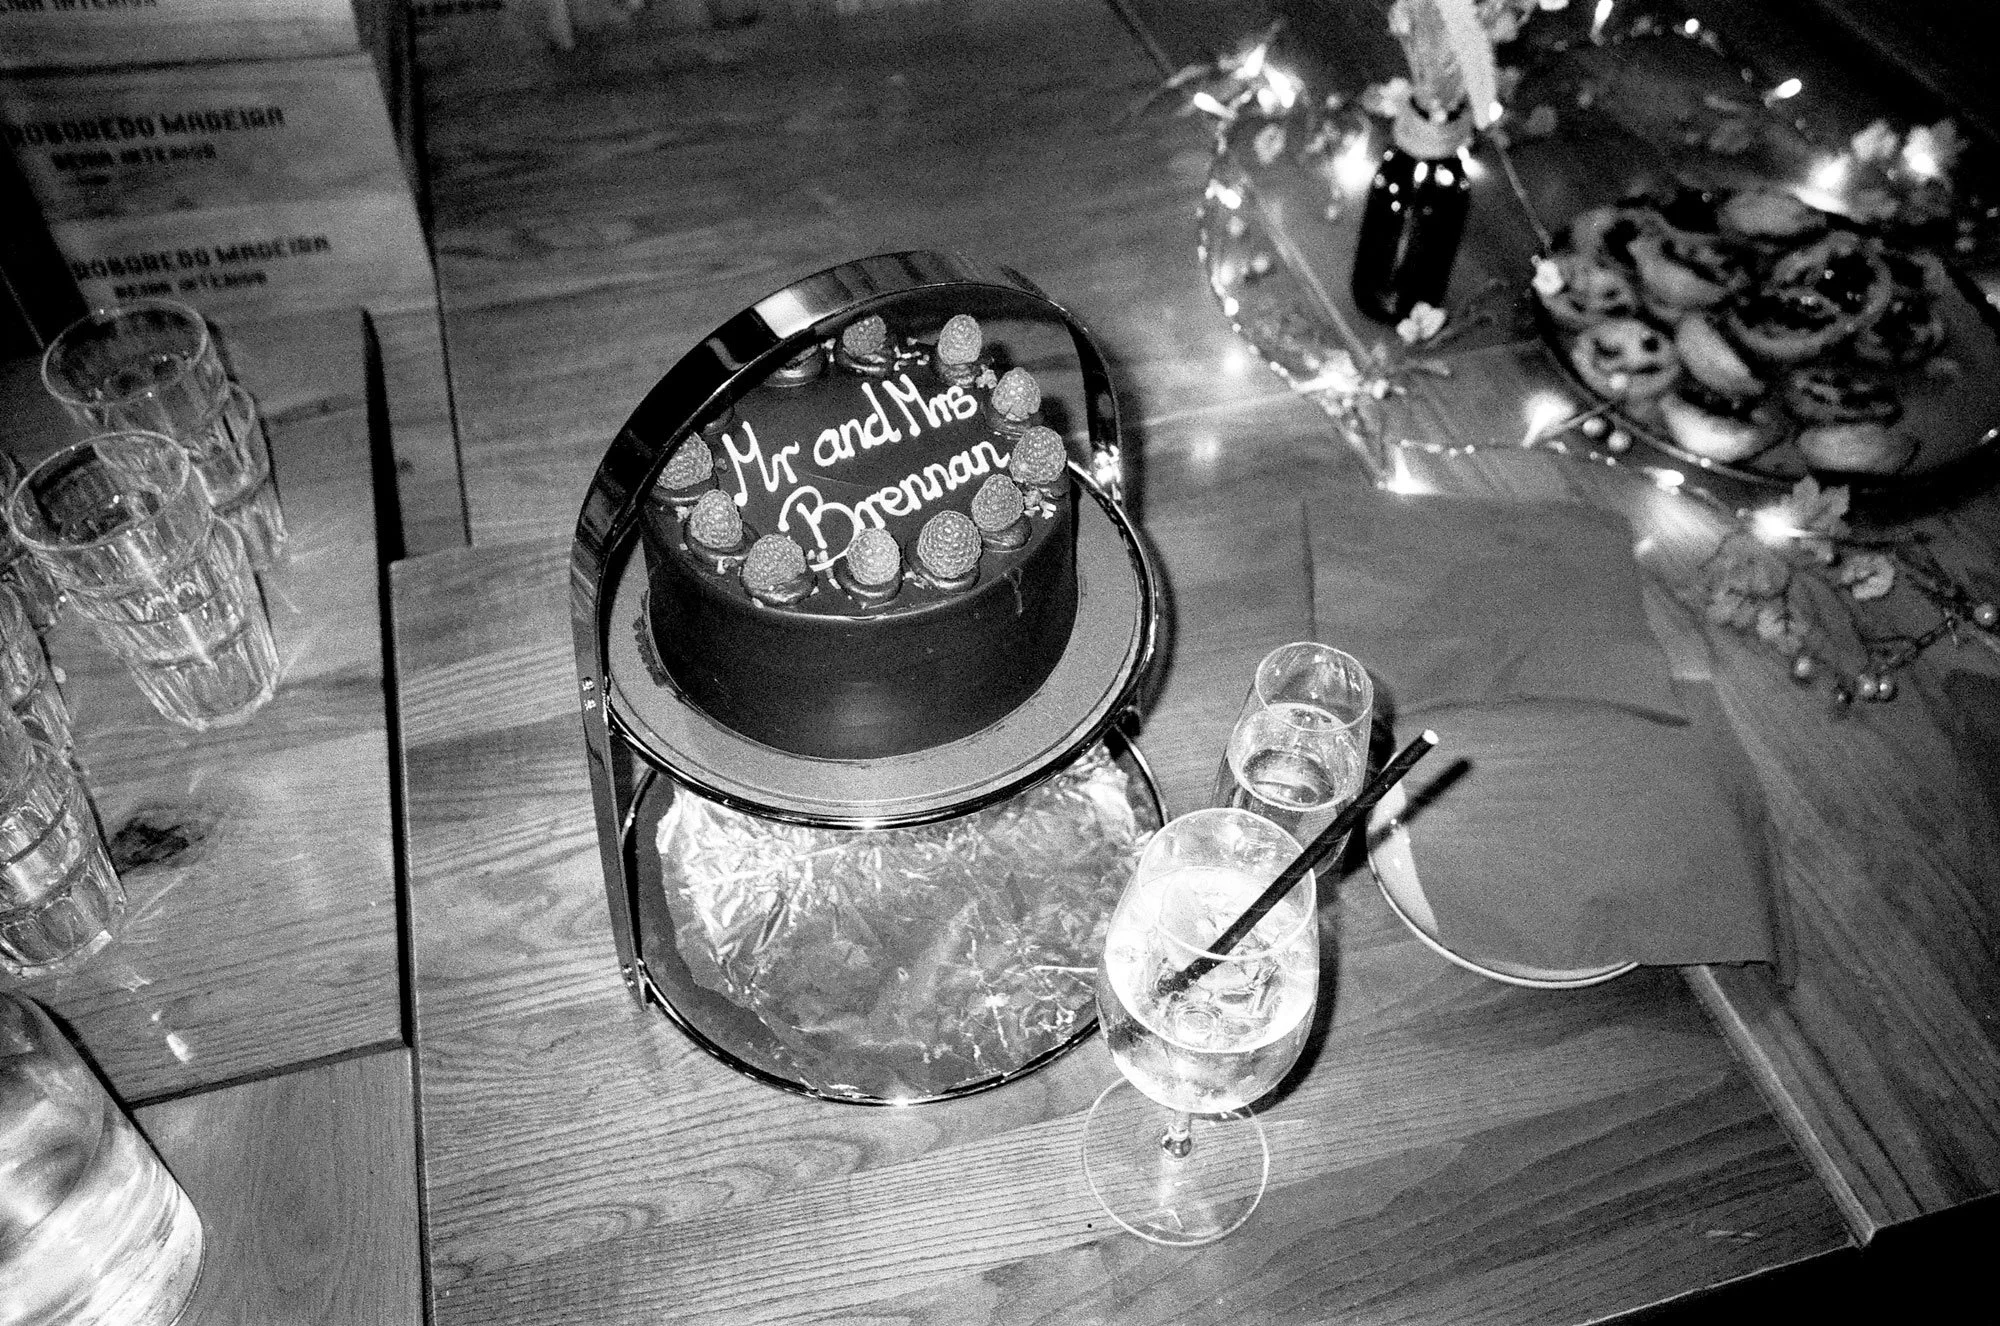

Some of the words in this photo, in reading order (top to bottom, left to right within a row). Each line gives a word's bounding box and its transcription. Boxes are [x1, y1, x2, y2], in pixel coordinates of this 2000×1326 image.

[721, 420, 801, 507] Mr
[813, 381, 903, 467] and
[881, 373, 978, 437] Mrs
[777, 440, 1010, 572] Brennan
